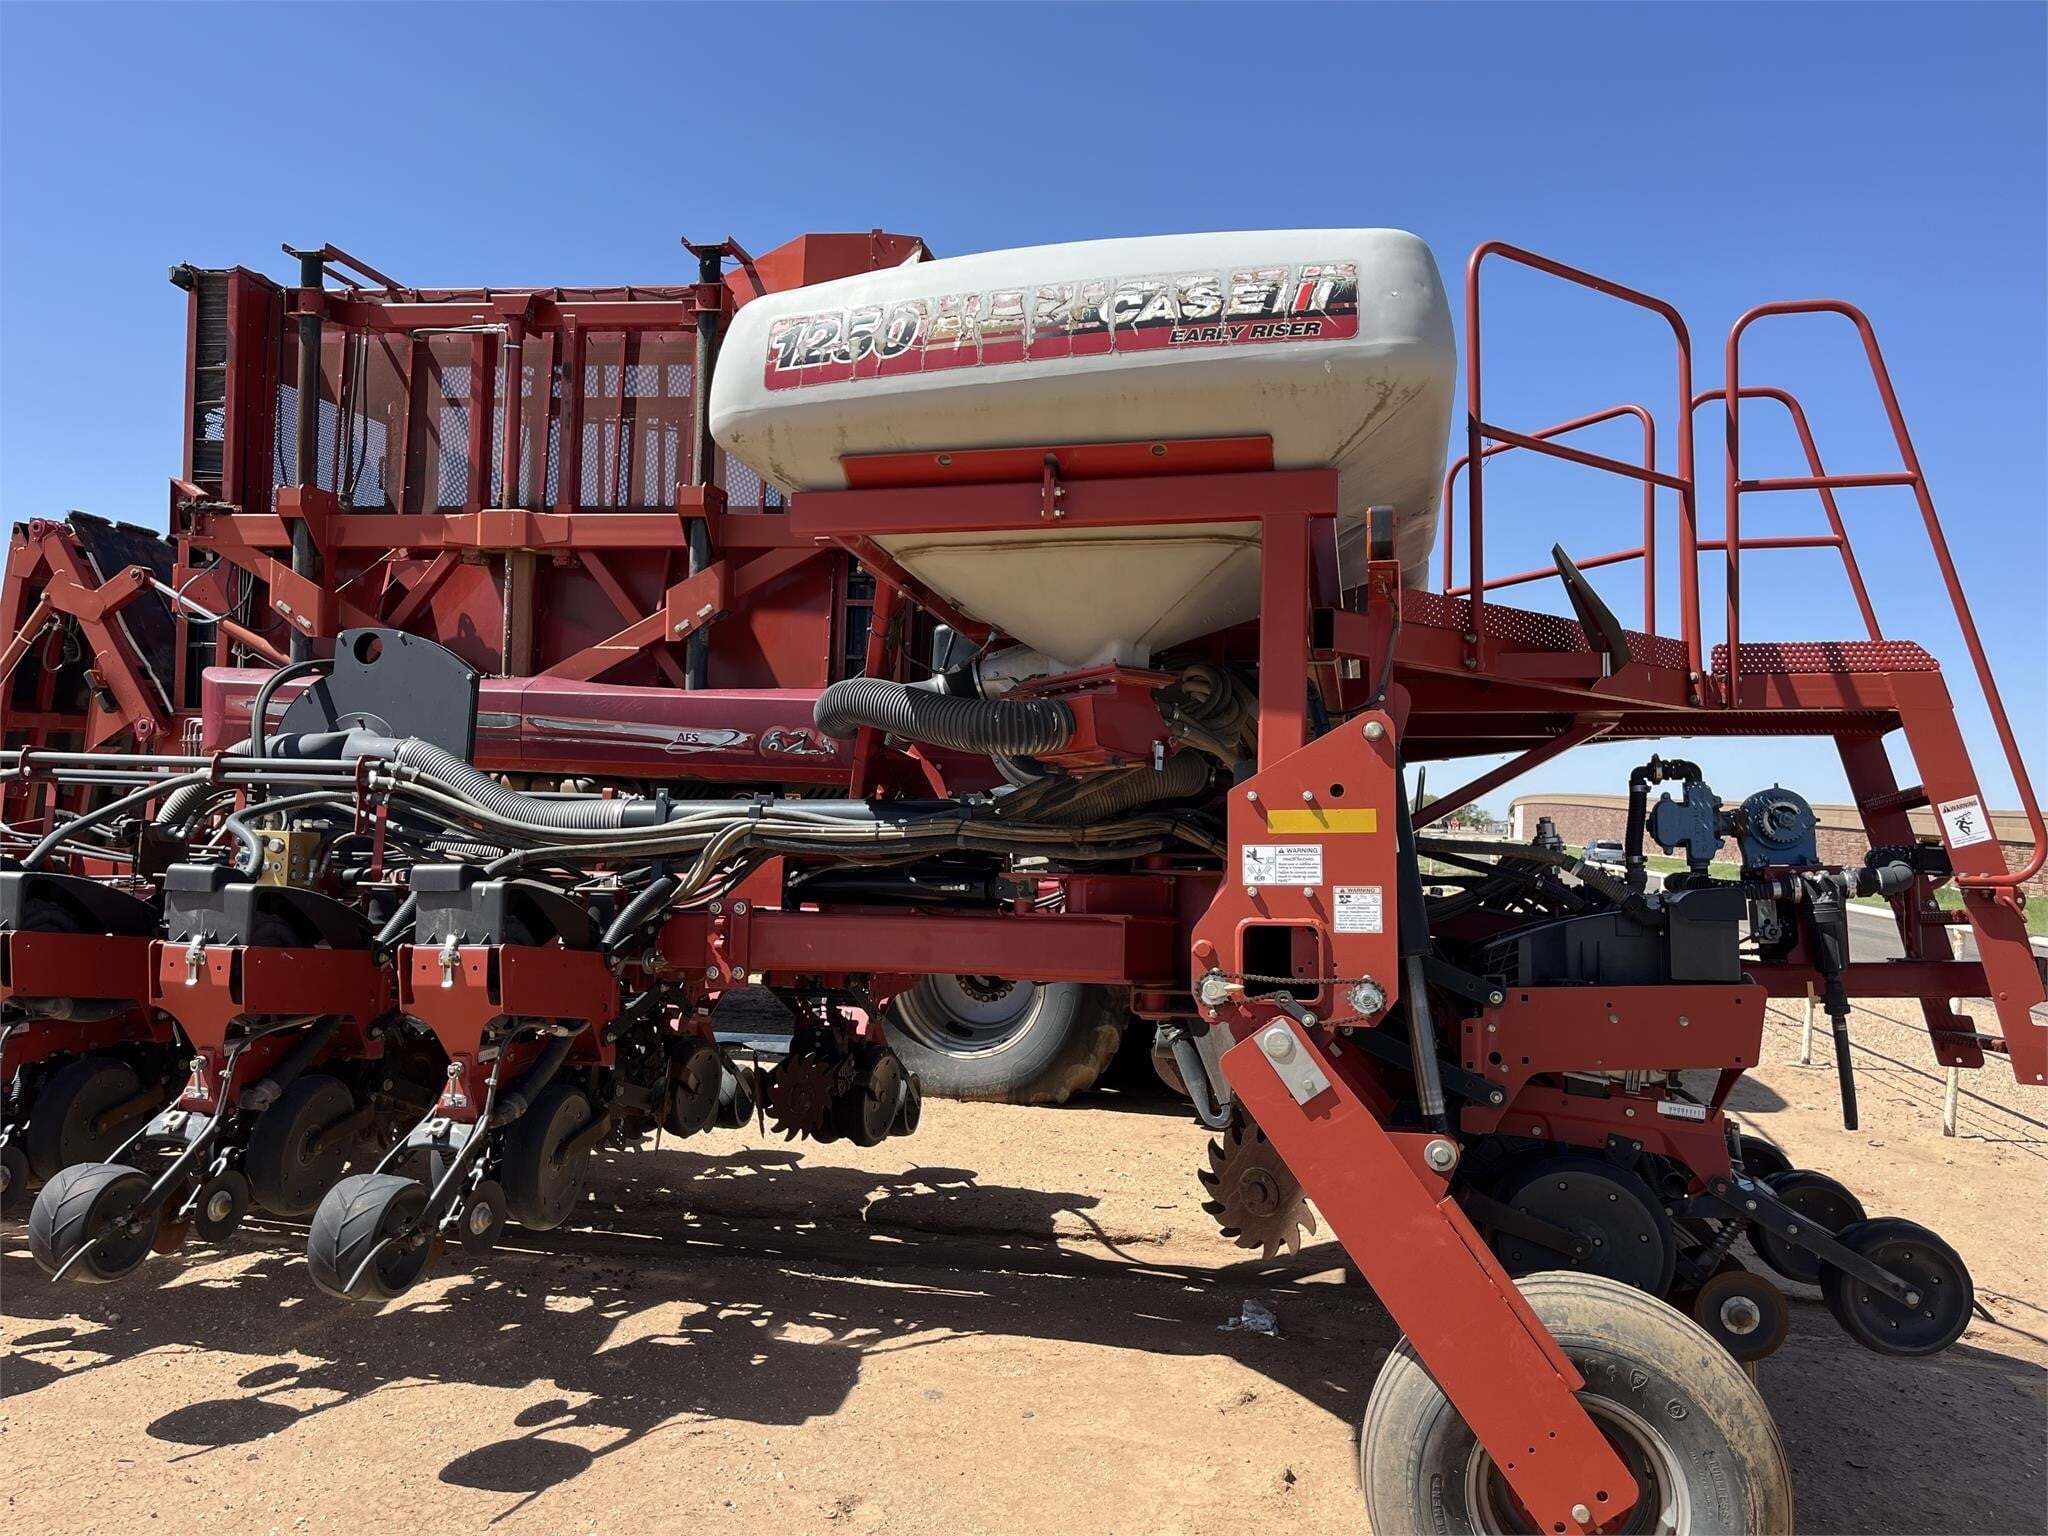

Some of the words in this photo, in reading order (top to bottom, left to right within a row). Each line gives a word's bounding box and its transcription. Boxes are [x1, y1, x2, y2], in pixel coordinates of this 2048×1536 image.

[774, 306, 920, 372] 1250
[1167, 324, 1245, 344] EARLY
[1249, 320, 1322, 339] RISER
[677, 732, 698, 742] AFS
[1950, 800, 1978, 812] WARNING
